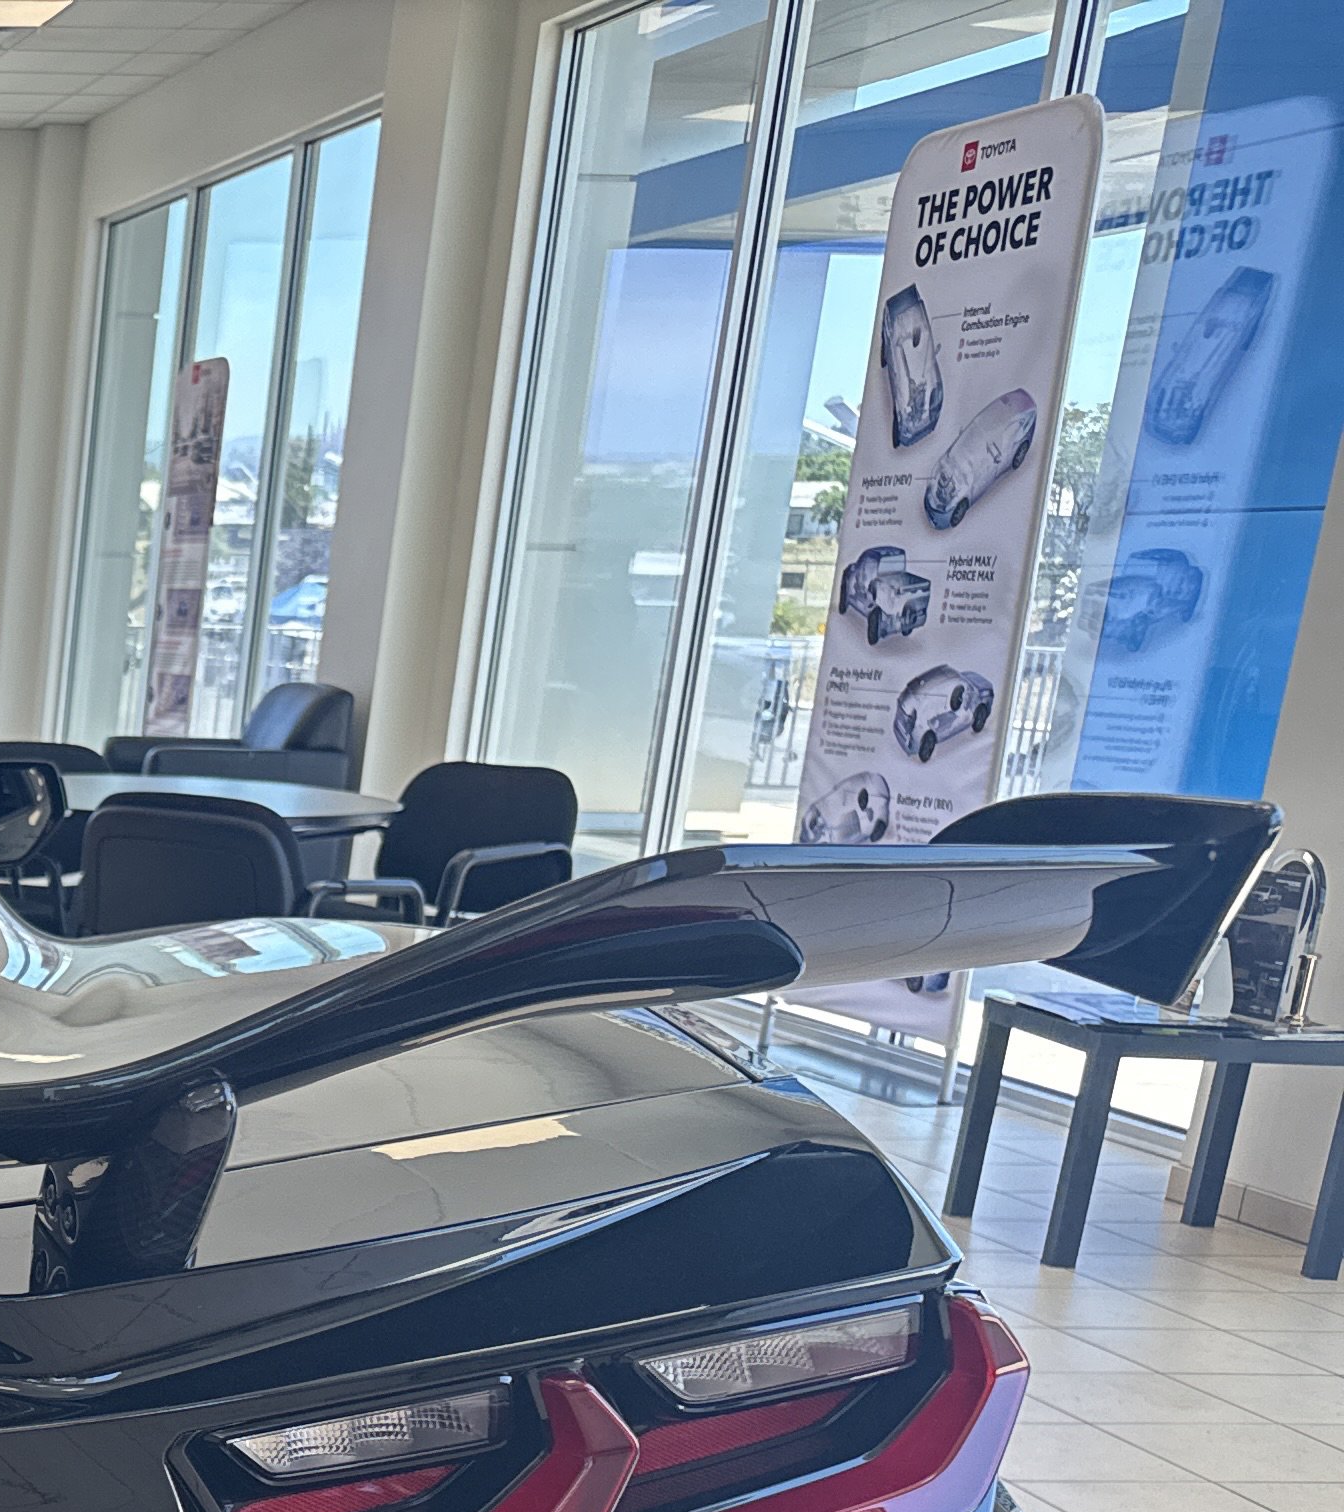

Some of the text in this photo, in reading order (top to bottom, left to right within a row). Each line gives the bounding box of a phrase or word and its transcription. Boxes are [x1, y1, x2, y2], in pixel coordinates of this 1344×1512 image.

[980, 138, 1017, 160] TOYOTA
[917, 166, 1054, 229] THE POWER
[915, 210, 1042, 268] OF CHOICE
[963, 302, 992, 317] Internal
[961, 312, 1030, 332] Combustion Engine
[949, 555, 973, 569] Hybrid
[974, 555, 992, 567] MAX
[977, 570, 995, 581] MAX
[896, 793, 922, 809] Battery
[923, 796, 933, 809] EV
